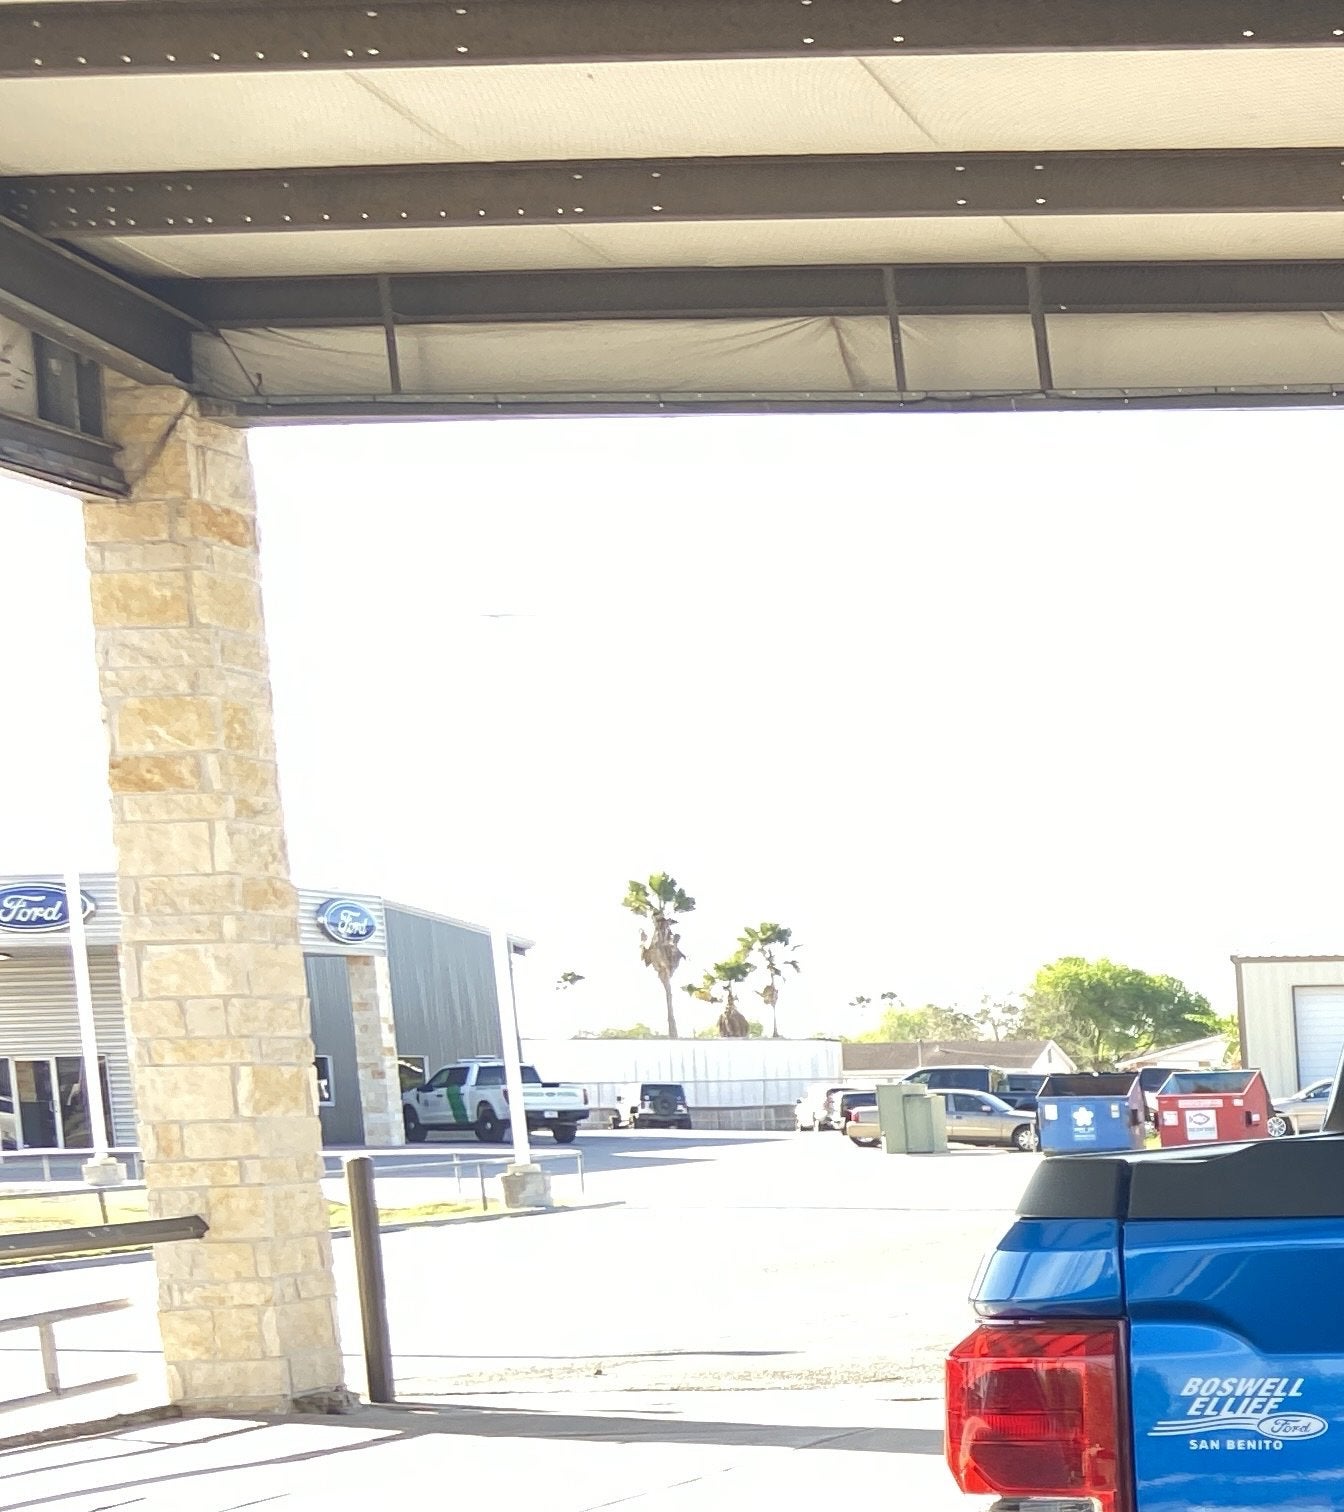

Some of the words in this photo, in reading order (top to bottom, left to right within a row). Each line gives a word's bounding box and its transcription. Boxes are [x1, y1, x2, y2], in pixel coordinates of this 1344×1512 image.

[0, 895, 63, 922] Ford
[338, 909, 368, 935] Ford
[1180, 1377, 1305, 1397] BOSWELL
[1186, 1397, 1284, 1416] ELLIFF
[1271, 1419, 1312, 1433] Ford
[1189, 1440, 1220, 1450] SAN
[1226, 1440, 1283, 1450] BENITO
